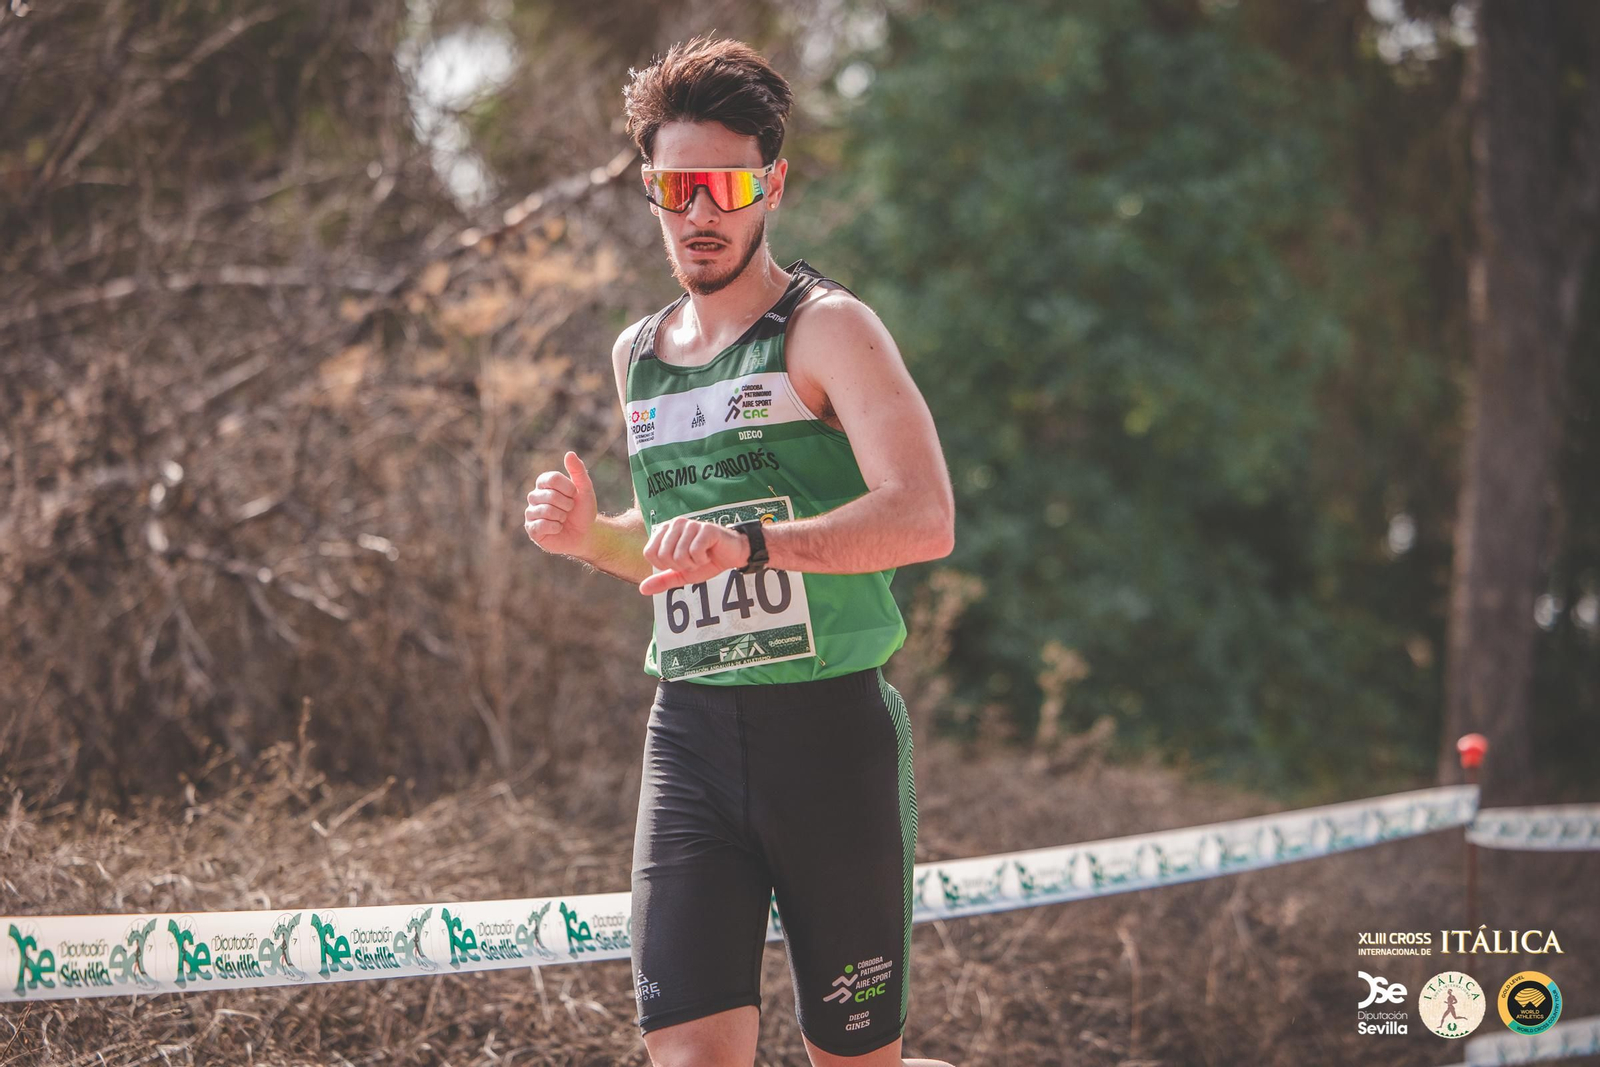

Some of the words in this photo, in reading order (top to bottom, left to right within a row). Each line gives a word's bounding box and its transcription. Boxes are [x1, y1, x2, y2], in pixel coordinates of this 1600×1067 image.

[755, 399, 772, 407] SPORT
[743, 408, 768, 419] CAC
[738, 430, 763, 440] DIEGO
[666, 568, 791, 634] 6140
[355, 946, 400, 970] Sevilla
[857, 956, 883, 969] CÓRDOBA
[216, 953, 264, 979] Sevilla
[861, 960, 893, 976] PATRIMONIO
[856, 978, 871, 989] AIRE
[872, 970, 892, 984] SPORT
[855, 983, 886, 1002] CAC
[849, 1011, 869, 1021] DIEGO
[845, 1019, 870, 1031] GINES
